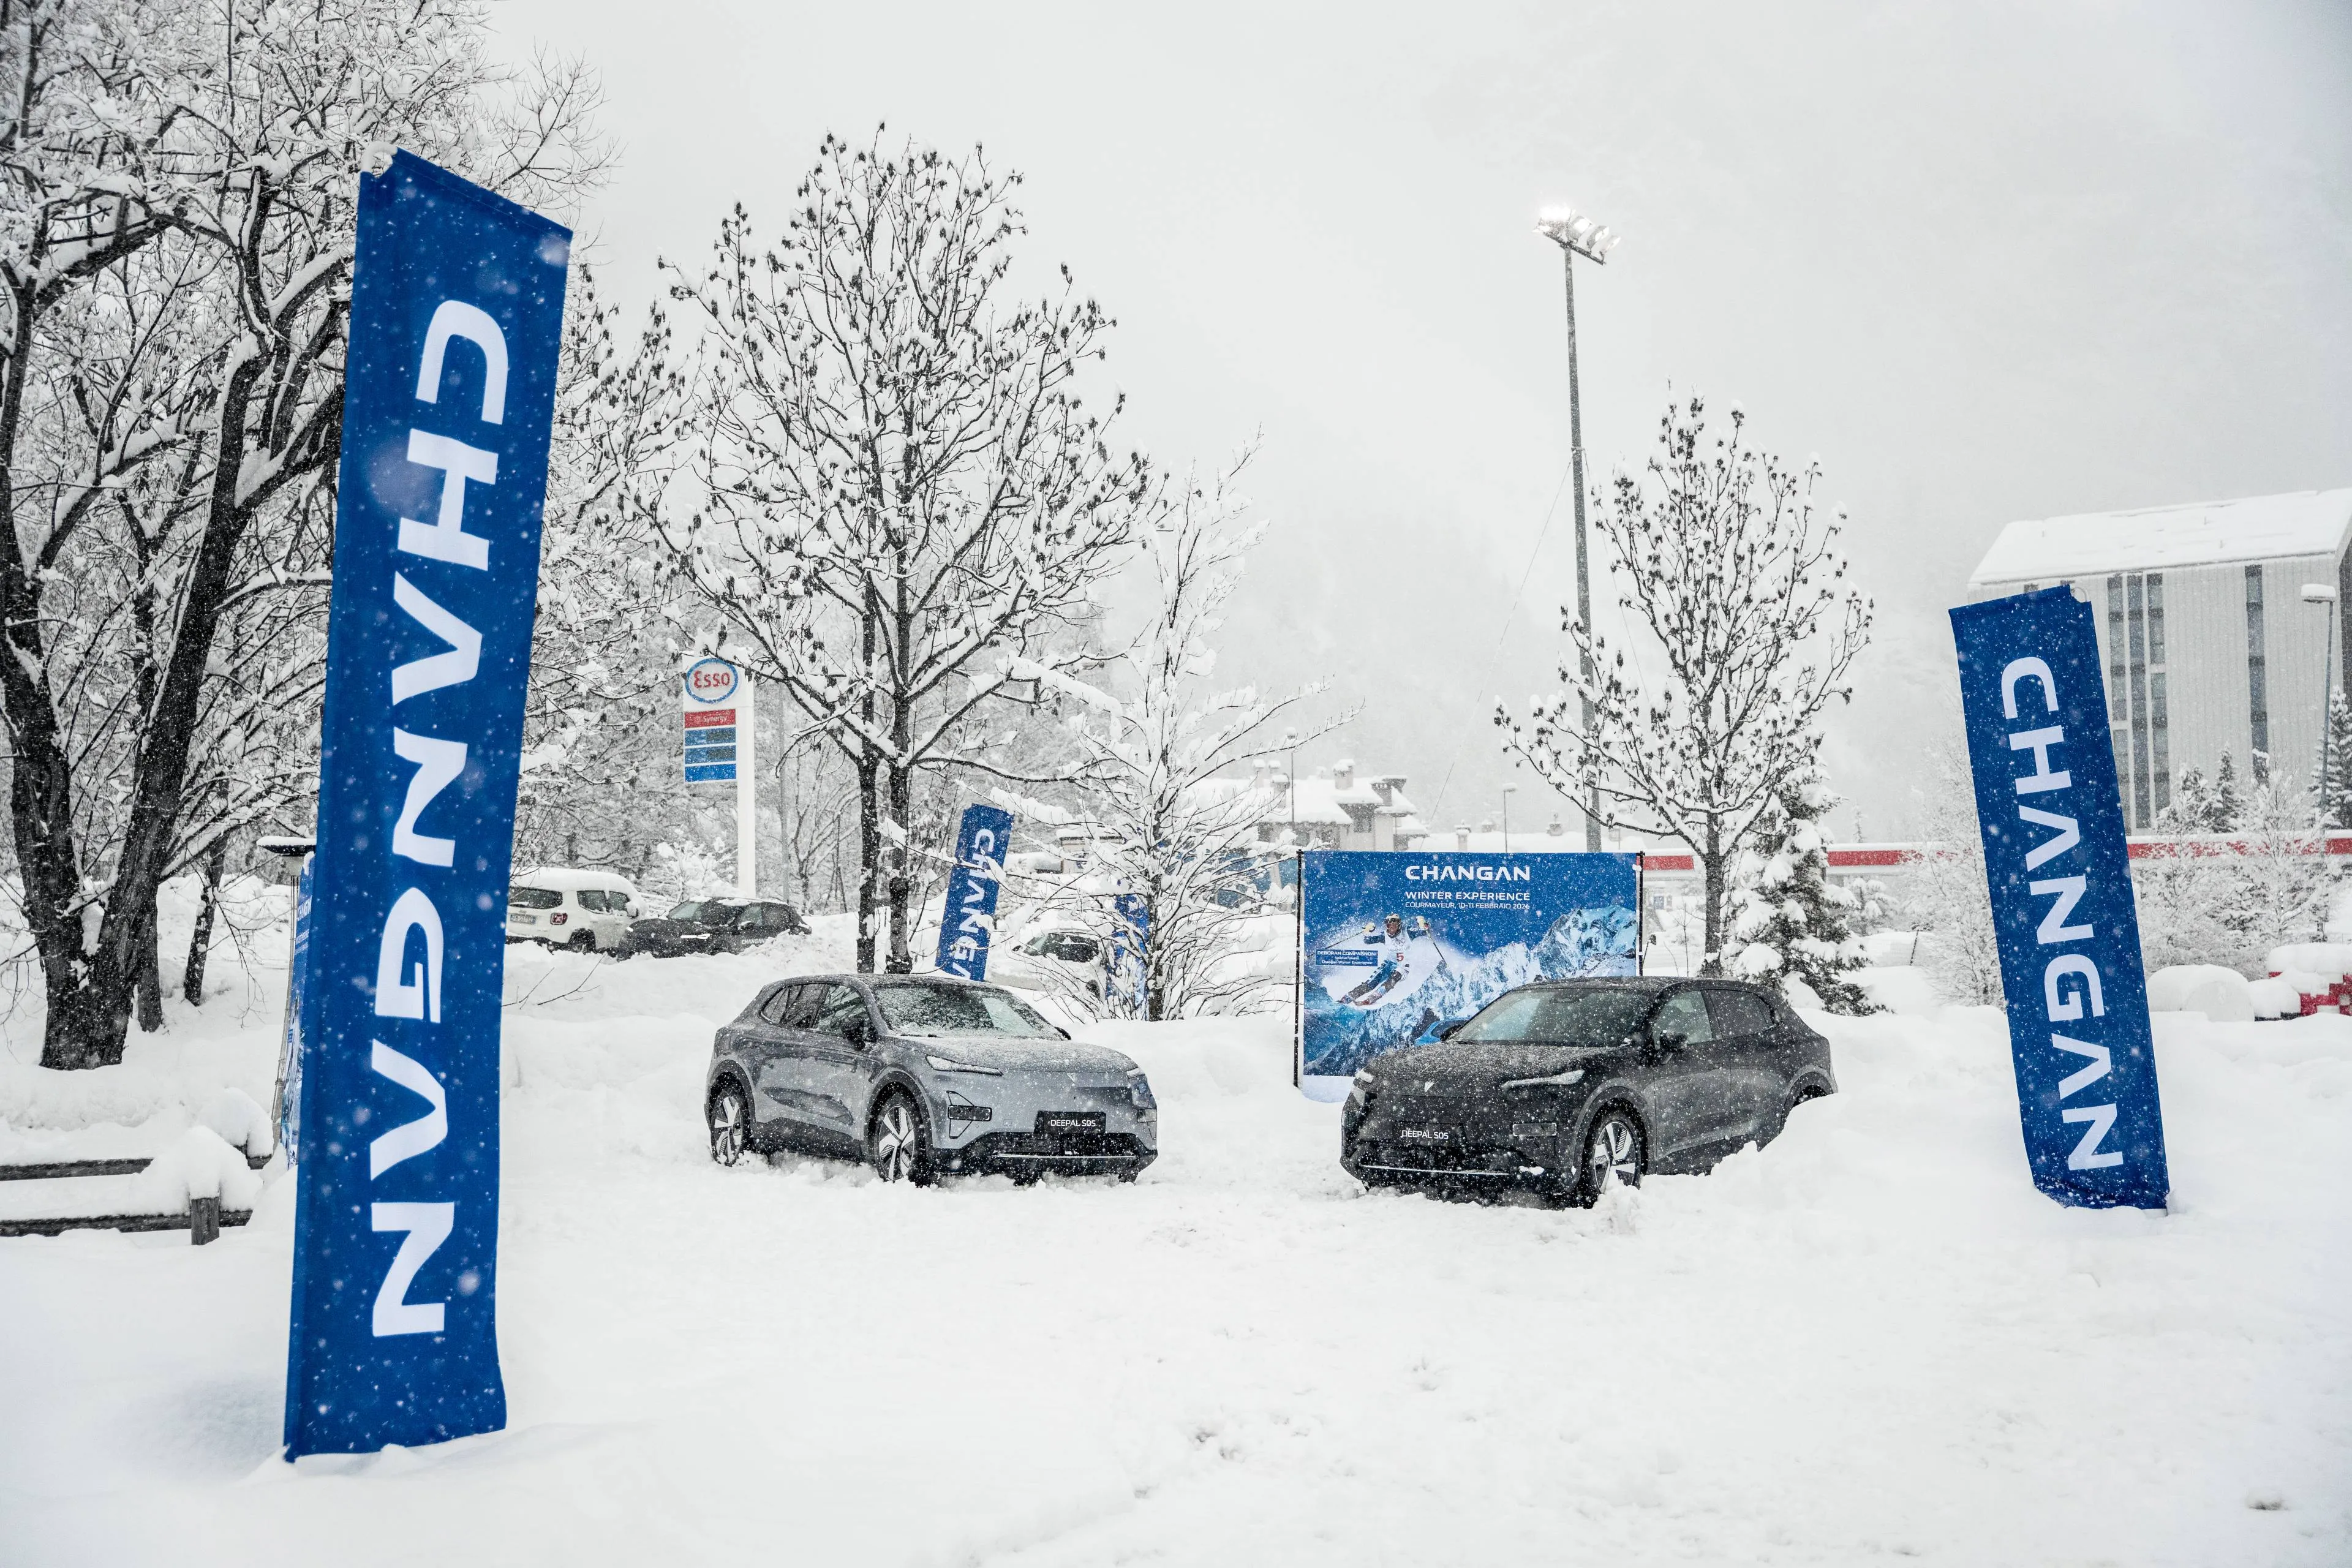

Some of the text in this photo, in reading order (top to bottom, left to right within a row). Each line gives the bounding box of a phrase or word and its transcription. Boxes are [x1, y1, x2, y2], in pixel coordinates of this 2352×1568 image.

[370, 300, 508, 1336] CHANGAN
[1405, 865, 1530, 881] CHANGAN
[1405, 891, 1530, 900] WINTER EXPERIENCE
[2001, 657, 2124, 1170] CHANGAN
[1401, 1129, 1433, 1139] DEEPAL
